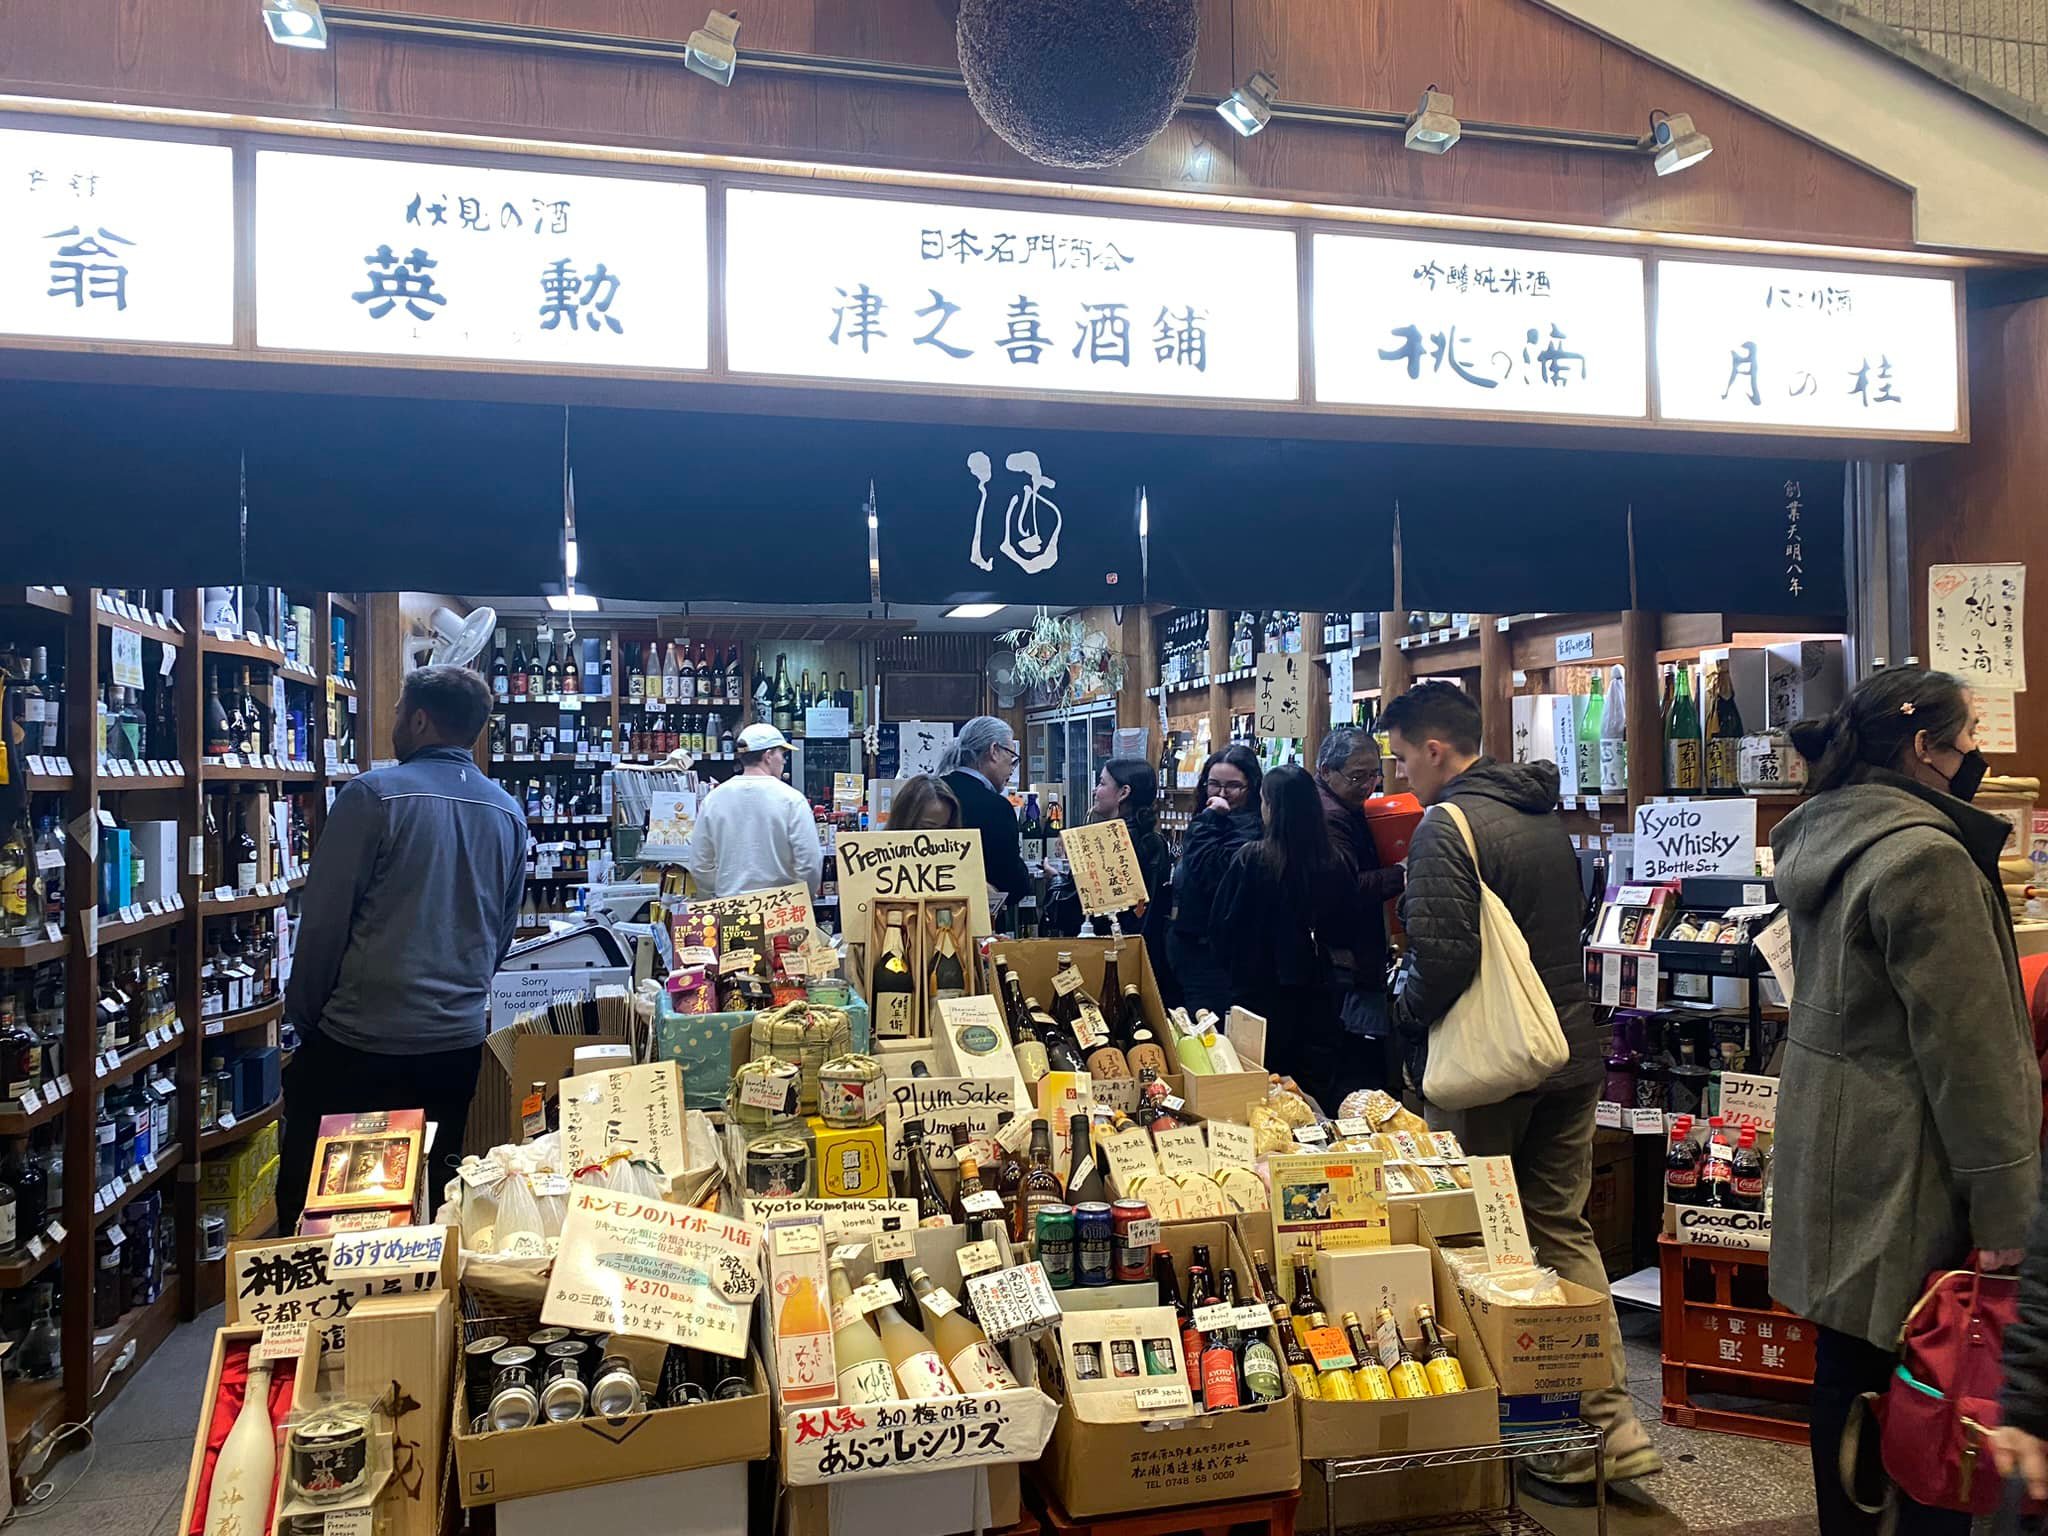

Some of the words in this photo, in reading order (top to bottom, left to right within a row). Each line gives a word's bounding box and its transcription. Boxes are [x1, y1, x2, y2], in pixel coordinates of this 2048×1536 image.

[405, 192, 572, 235] 伏見の酒
[41, 225, 137, 312] 翁
[1378, 322, 1588, 389] 桃の滴
[1721, 340, 1902, 408] 月の桂
[967, 450, 1063, 575] 酒
[1783, 479, 1804, 598] 創業天明八年
[1638, 808, 1702, 840] Kyoto
[839, 841, 916, 876] Premium
[914, 833, 972, 861] Quality
[1658, 831, 1740, 858] Whisky
[875, 864, 956, 894] SAKE
[1644, 860, 1657, 878] 3
[1658, 859, 1695, 875] Bottle
[1696, 859, 1719, 872] Set
[493, 989, 512, 999] You
[514, 988, 549, 998] cannot
[521, 977, 549, 987] Sorry
[504, 1001, 526, 1010] food
[528, 1002, 540, 1010] or
[893, 1083, 954, 1119] Plum
[958, 1082, 1009, 1106] Sake
[751, 1200, 802, 1217] Kyoto
[867, 1199, 910, 1213] Sake
[841, 1216, 876, 1229] Normal
[333, 1236, 443, 1269] おすすめ地酒
[1207, 1377, 1233, 1385] CLASSIC
[1208, 1369, 1232, 1378] KYOTO
[794, 1406, 865, 1445] 大人気
[818, 1414, 1011, 1476] あらごしシリーズ
[1145, 1480, 1161, 1489] TEL
